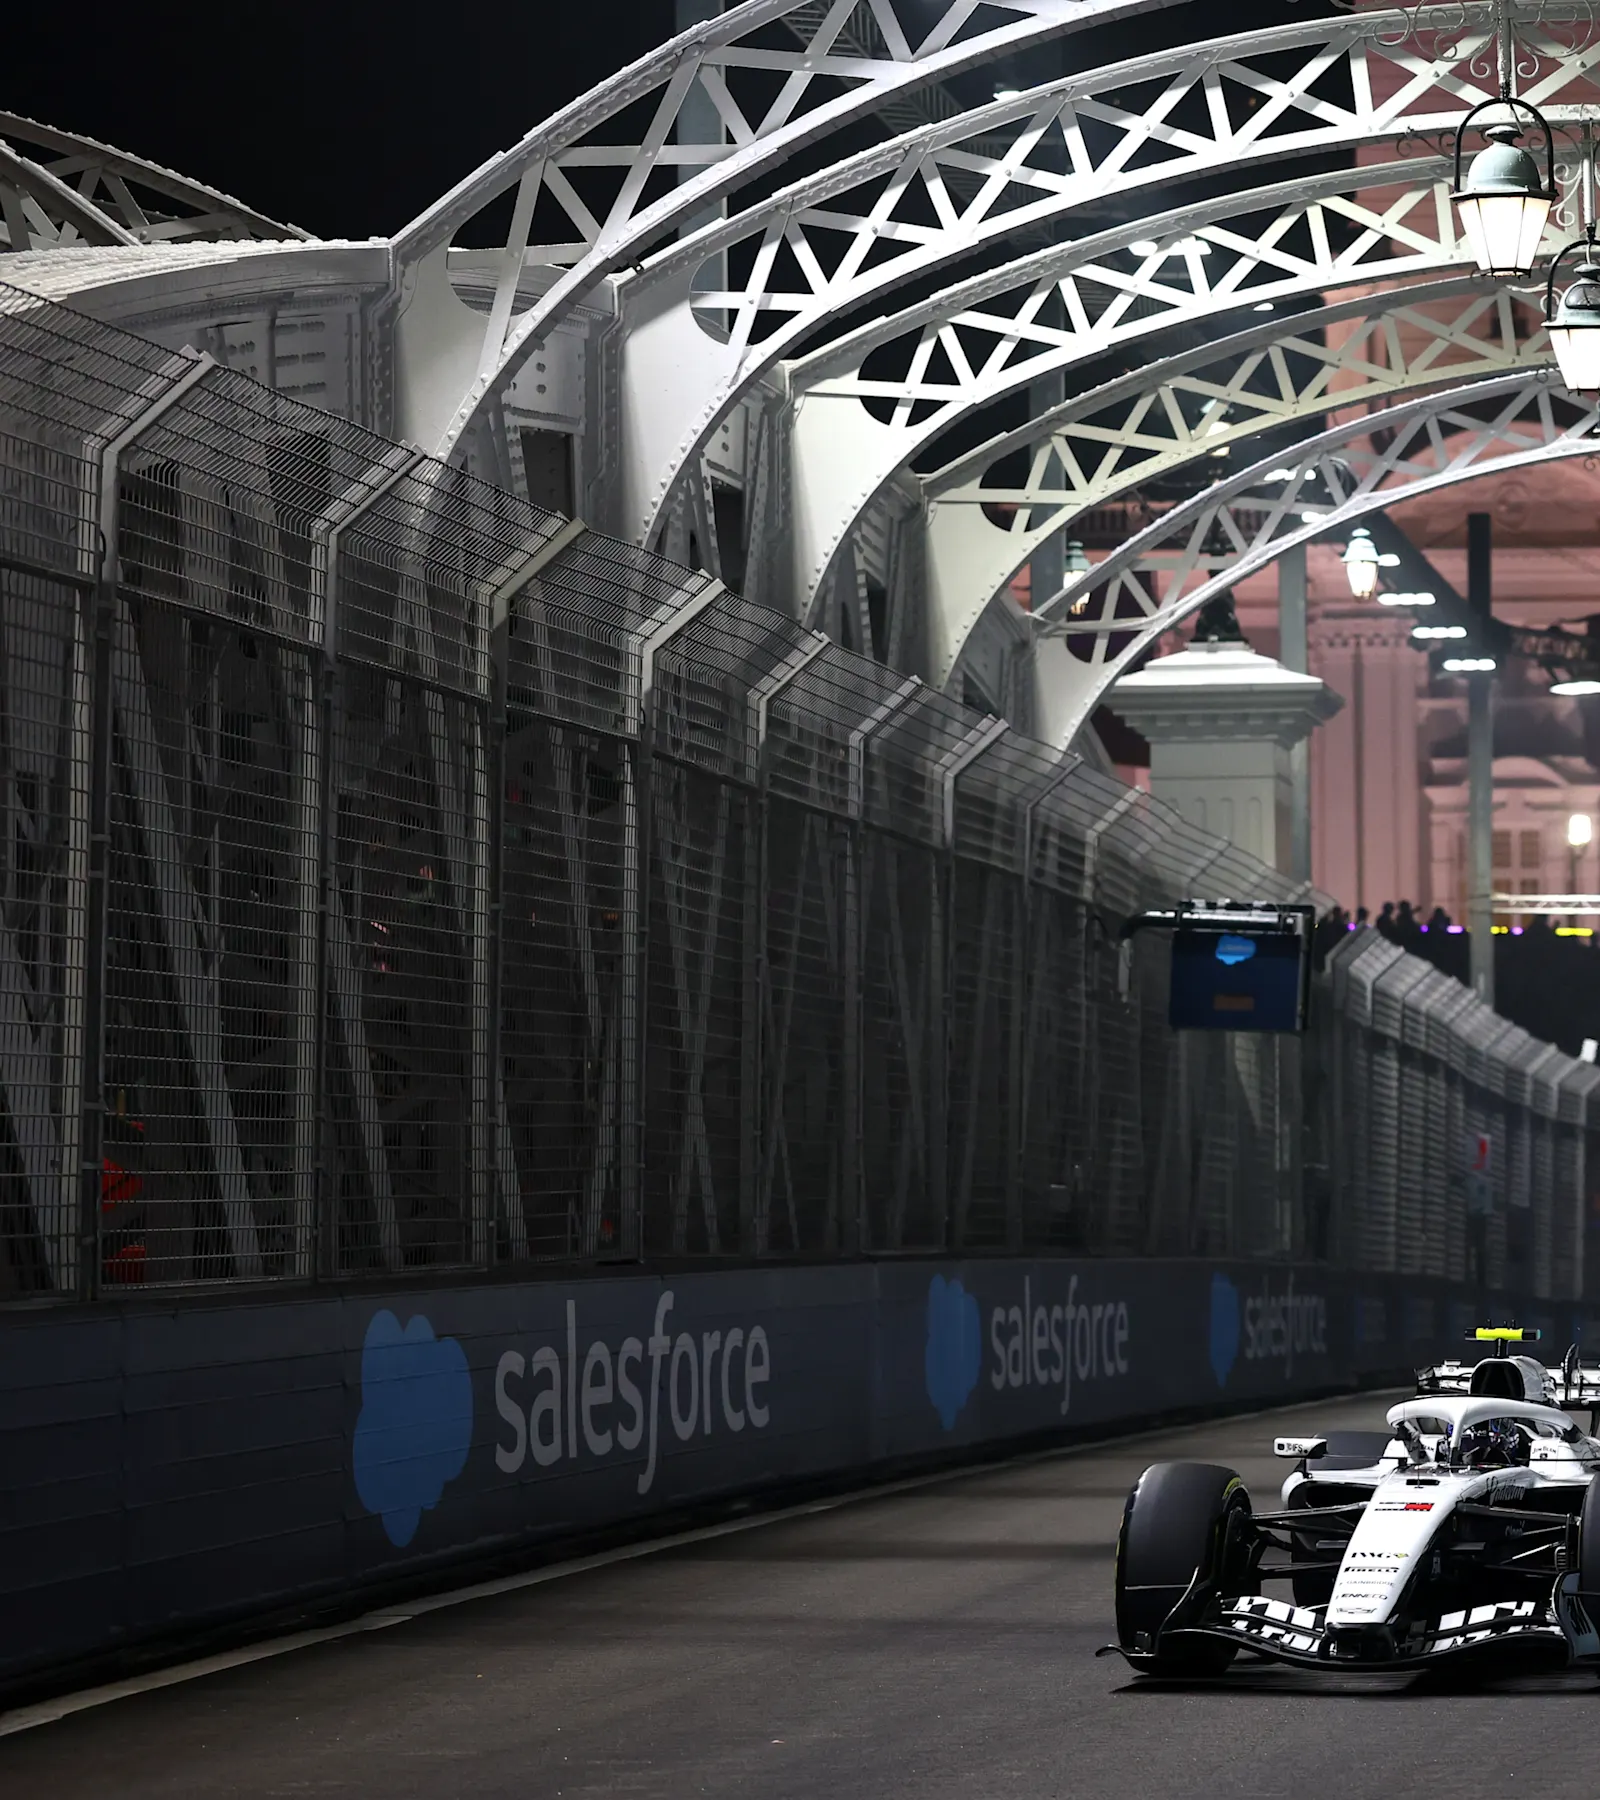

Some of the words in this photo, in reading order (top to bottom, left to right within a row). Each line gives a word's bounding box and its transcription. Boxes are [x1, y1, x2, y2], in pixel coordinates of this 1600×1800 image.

[493, 1290, 773, 1496] salesforce
[990, 1273, 1129, 1416] salesforce
[1244, 1270, 1327, 1380] salesforce
